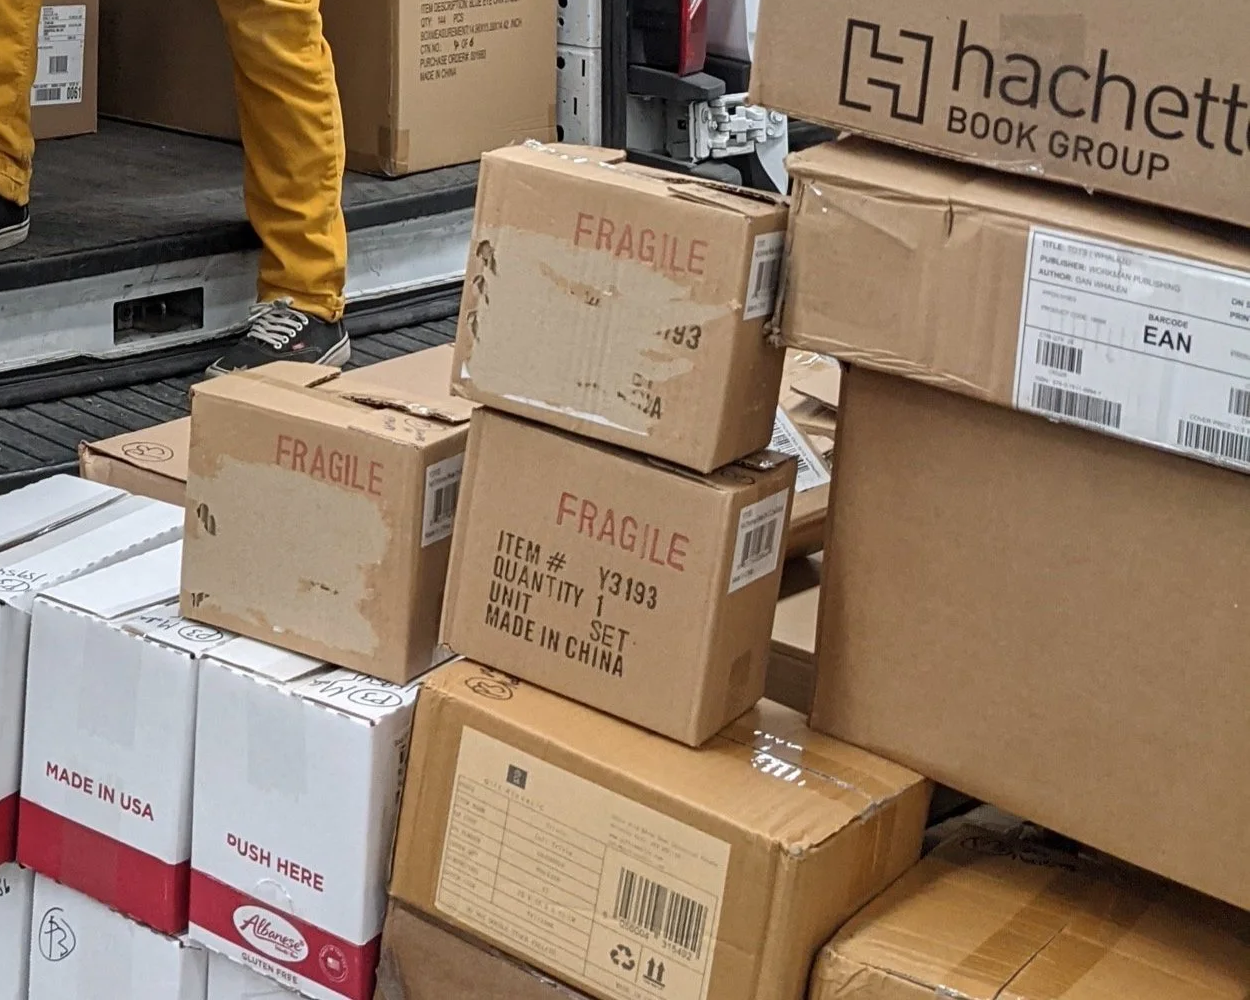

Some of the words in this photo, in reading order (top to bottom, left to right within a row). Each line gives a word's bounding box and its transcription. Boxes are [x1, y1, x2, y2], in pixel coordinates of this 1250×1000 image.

[952, 18, 1250, 157] hachett
[946, 104, 1039, 153] BOOK
[1049, 129, 1170, 181] GROUP
[573, 212, 710, 276] FRAGILE
[1144, 325, 1191, 354] EAN
[1148, 313, 1189, 330] BARCODE
[276, 434, 384, 496] FRAGILE
[556, 492, 690, 571] FRAGILE
[493, 555, 584, 608] QUANTITY
[596, 595, 604, 617] 1
[498, 530, 541, 565] ITEM
[546, 551, 567, 573] #
[599, 566, 658, 610] Y3193
[485, 603, 536, 642] MADE
[539, 626, 561, 653] IN
[564, 636, 624, 678] CHINA
[489, 580, 533, 614] UNIT
[589, 619, 630, 653] SET
[46, 761, 93, 795] MADE
[98, 783, 115, 804] IN
[121, 792, 154, 821] USA
[227, 832, 271, 868] PUSH
[277, 857, 324, 892] HERE
[240, 914, 304, 953] Albanese
[241, 952, 274, 973] GLUTEN
[276, 968, 298, 985] FREE
